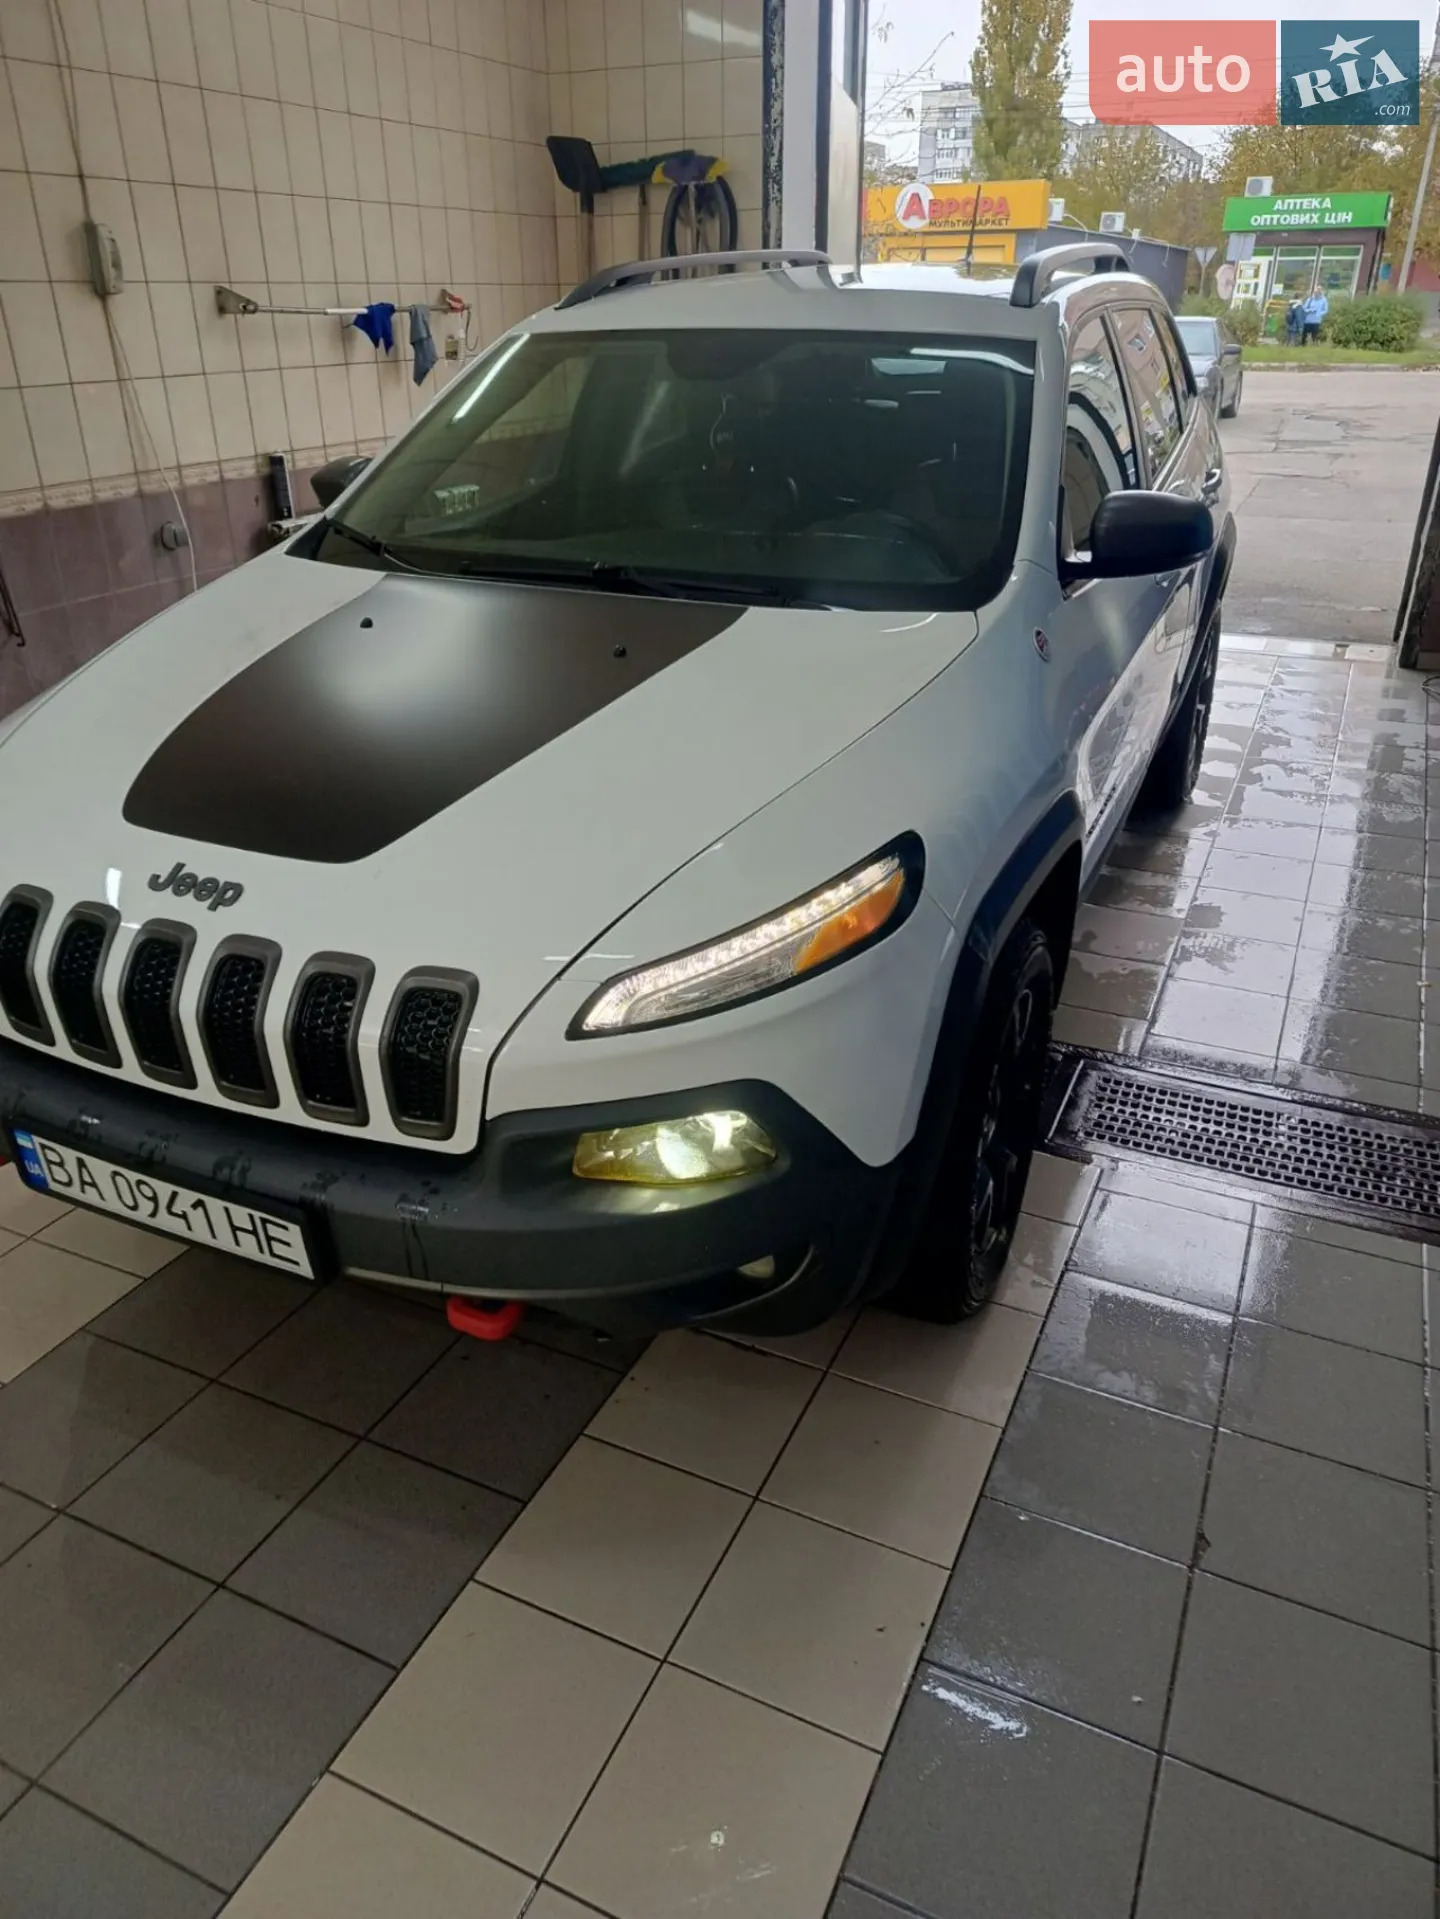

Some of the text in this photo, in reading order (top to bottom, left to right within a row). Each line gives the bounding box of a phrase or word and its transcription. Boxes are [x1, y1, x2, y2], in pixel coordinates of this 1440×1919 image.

[902, 192, 1011, 221] АВРОРА
[1273, 197, 1332, 211] АПТЕКА
[1250, 211, 1353, 227] ОПТОВИХ ЦІН
[148, 862, 245, 912] Jeep
[24, 1159, 46, 1177] UA
[39, 1142, 301, 1267] BA 0941 HE
